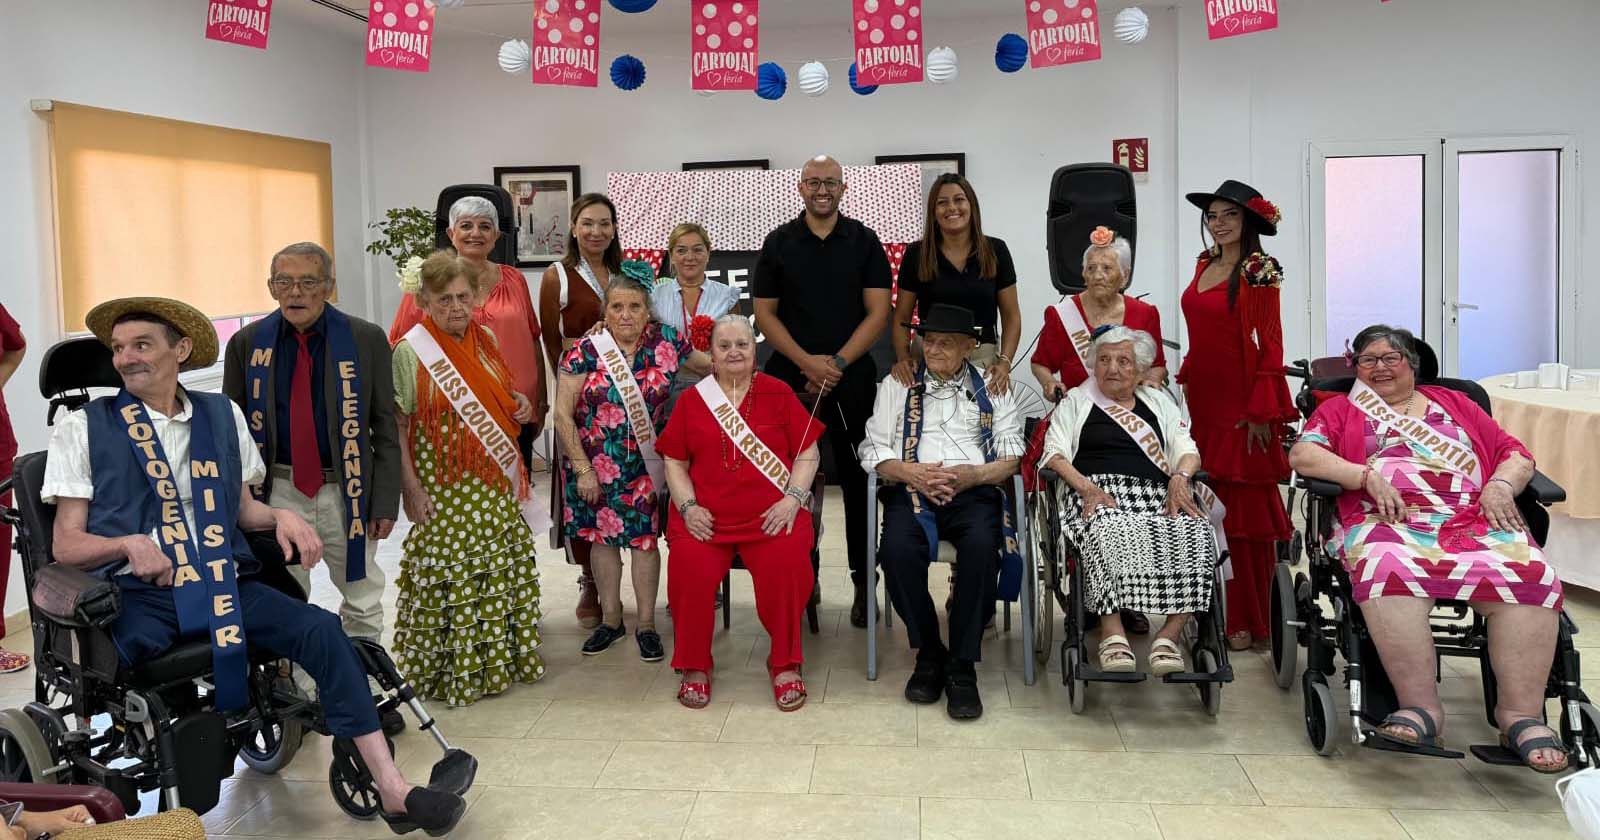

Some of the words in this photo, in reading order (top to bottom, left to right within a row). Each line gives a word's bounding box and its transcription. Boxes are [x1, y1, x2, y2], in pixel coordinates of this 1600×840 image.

[208, 3, 267, 36] CARTOJAL
[368, 28, 429, 59] CARTOJAL
[1030, 21, 1098, 56] CARTOJAL
[534, 46, 597, 74] CARTOJAL
[693, 51, 757, 77] CARTOJAL
[857, 44, 922, 73] CARTOJAL
[603, 348, 629, 383] MISS
[429, 358, 468, 402] MISS
[461, 401, 518, 470] COQUETA
[1355, 389, 1395, 422] MISS
[338, 361, 365, 540] ELEGANCIA
[713, 402, 745, 438] MISS
[739, 433, 789, 489] RESIDE
[1104, 405, 1145, 433] MISS
[1139, 431, 1170, 474] FOTO
[120, 403, 201, 588] FOTOGENIA
[191, 460, 242, 648] MISTER
